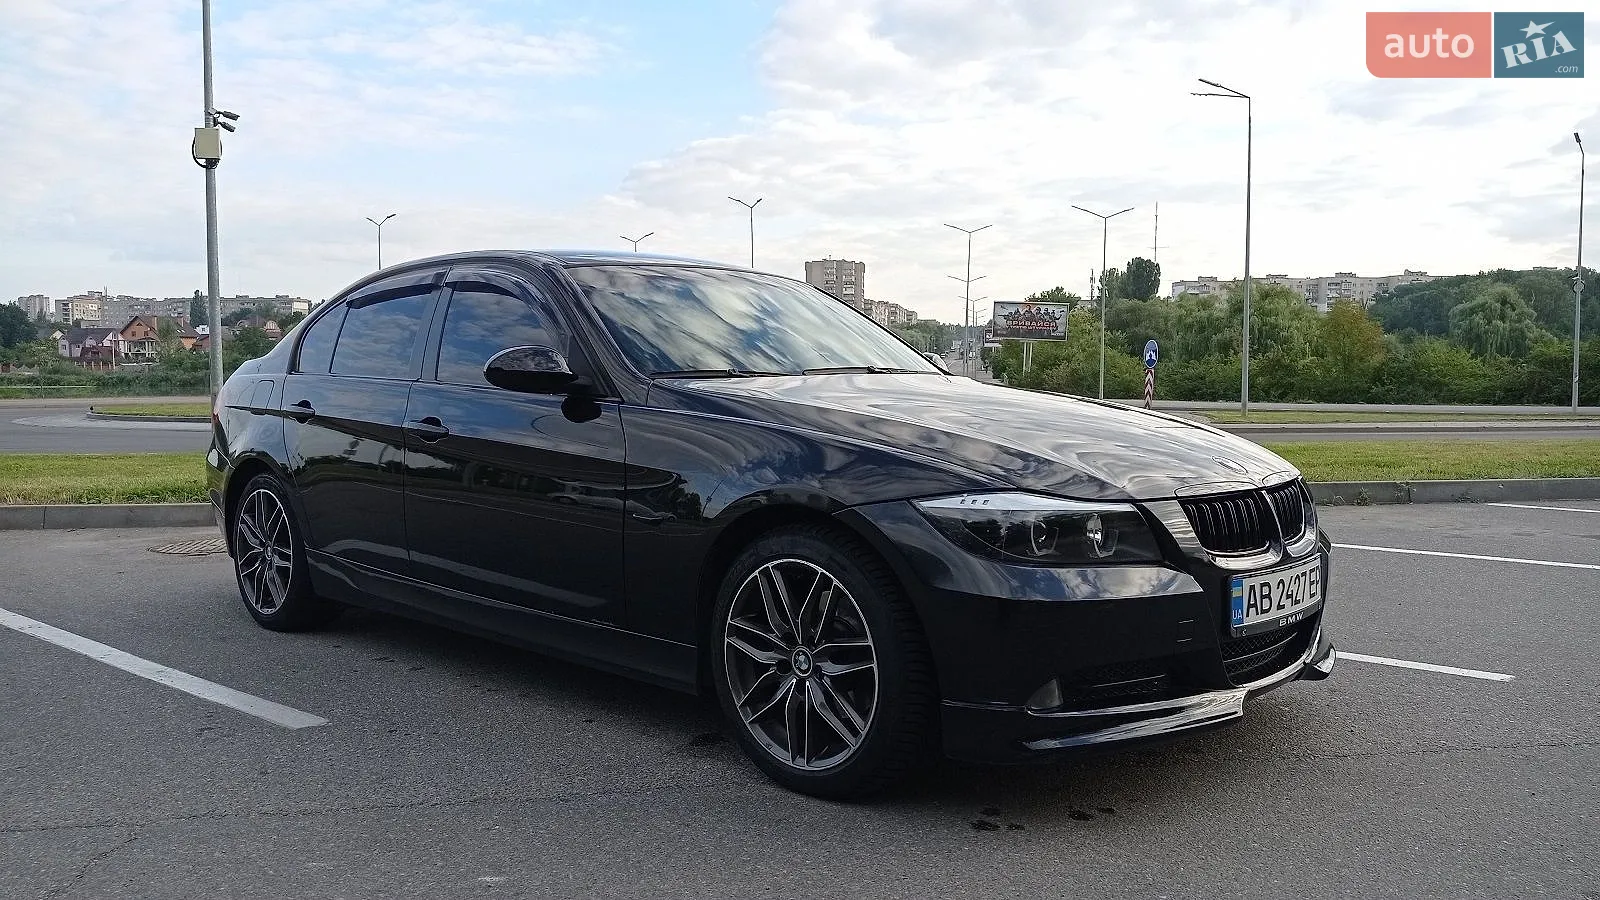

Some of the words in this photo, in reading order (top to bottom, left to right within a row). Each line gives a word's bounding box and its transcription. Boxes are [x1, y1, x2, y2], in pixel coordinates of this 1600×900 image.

[1246, 581, 1273, 617] AB
[1276, 570, 1308, 611] 2427
[1308, 565, 1321, 599] EP
[1232, 609, 1243, 620] UA
[1279, 612, 1304, 626] BMW
